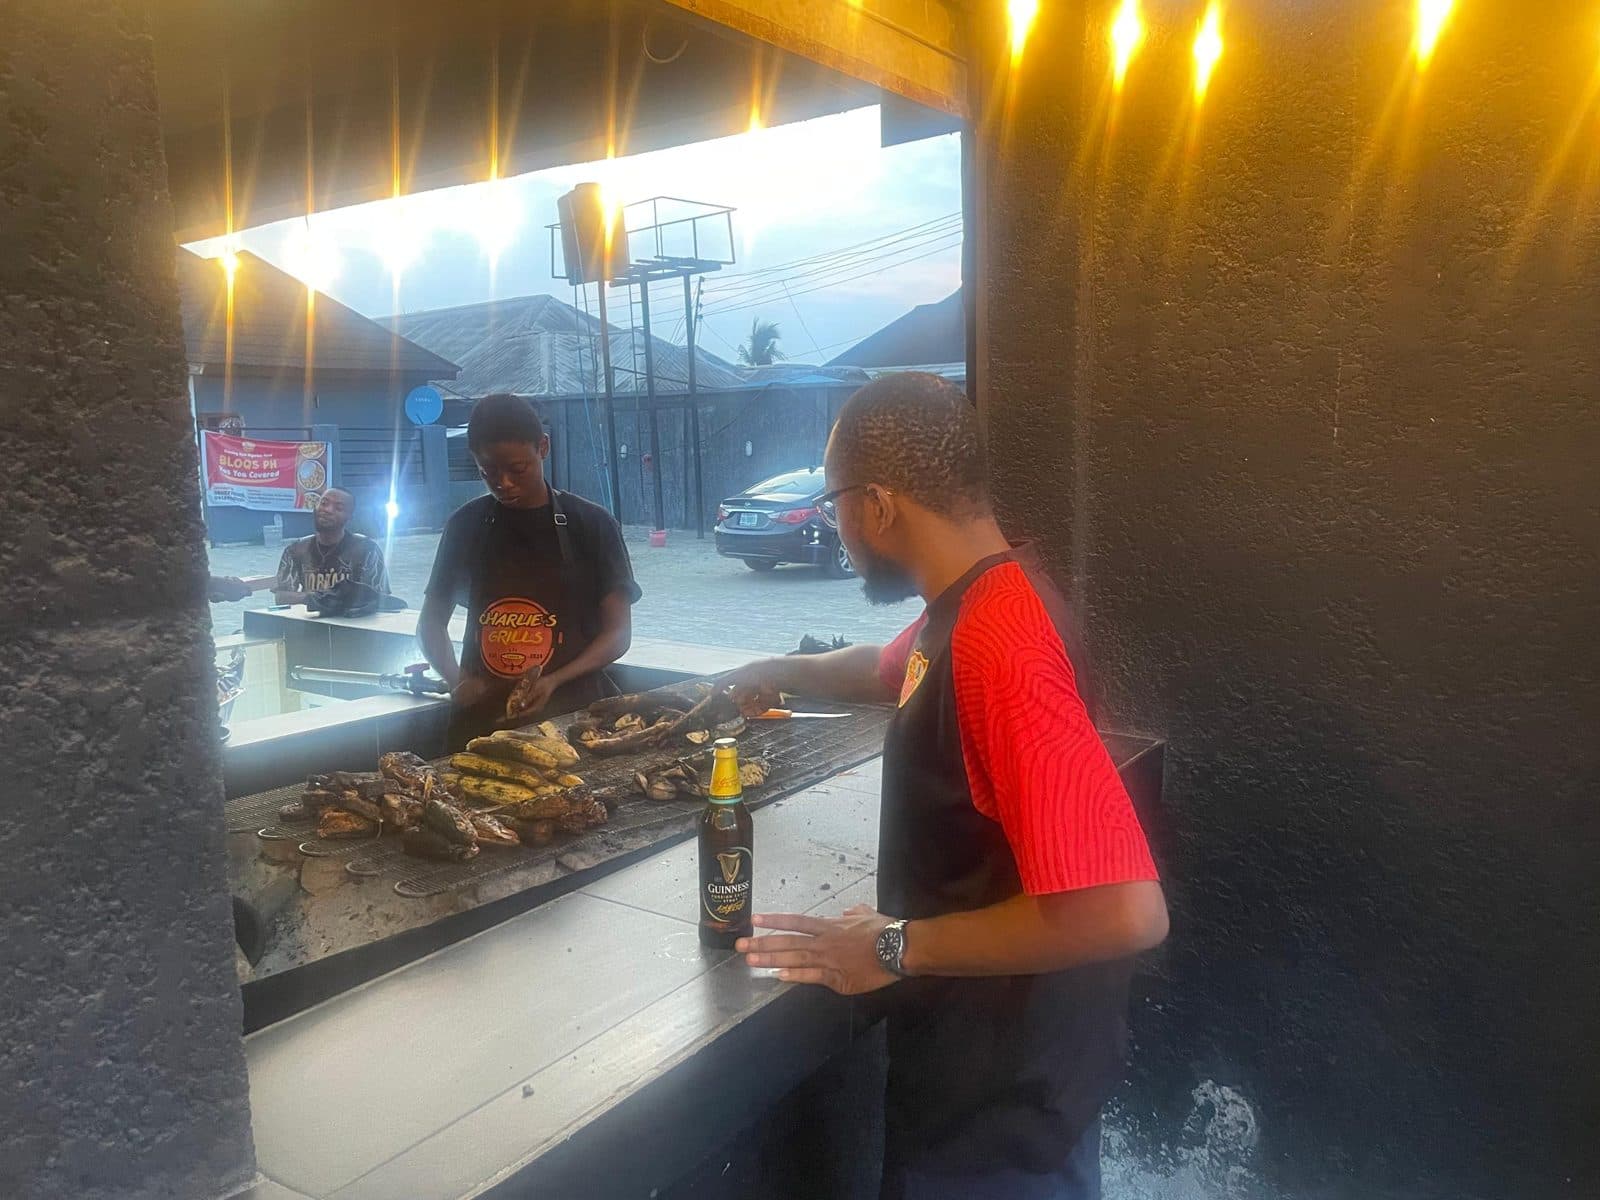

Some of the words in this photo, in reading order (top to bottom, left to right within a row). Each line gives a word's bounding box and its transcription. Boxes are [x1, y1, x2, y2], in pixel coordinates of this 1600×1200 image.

[262, 459, 277, 469] PH
[232, 469, 247, 478] You
[249, 469, 280, 479] Covered
[479, 611, 557, 628] CHARLIE'S
[488, 629, 544, 645] GRILLS
[707, 880, 750, 895] GUINNESS
